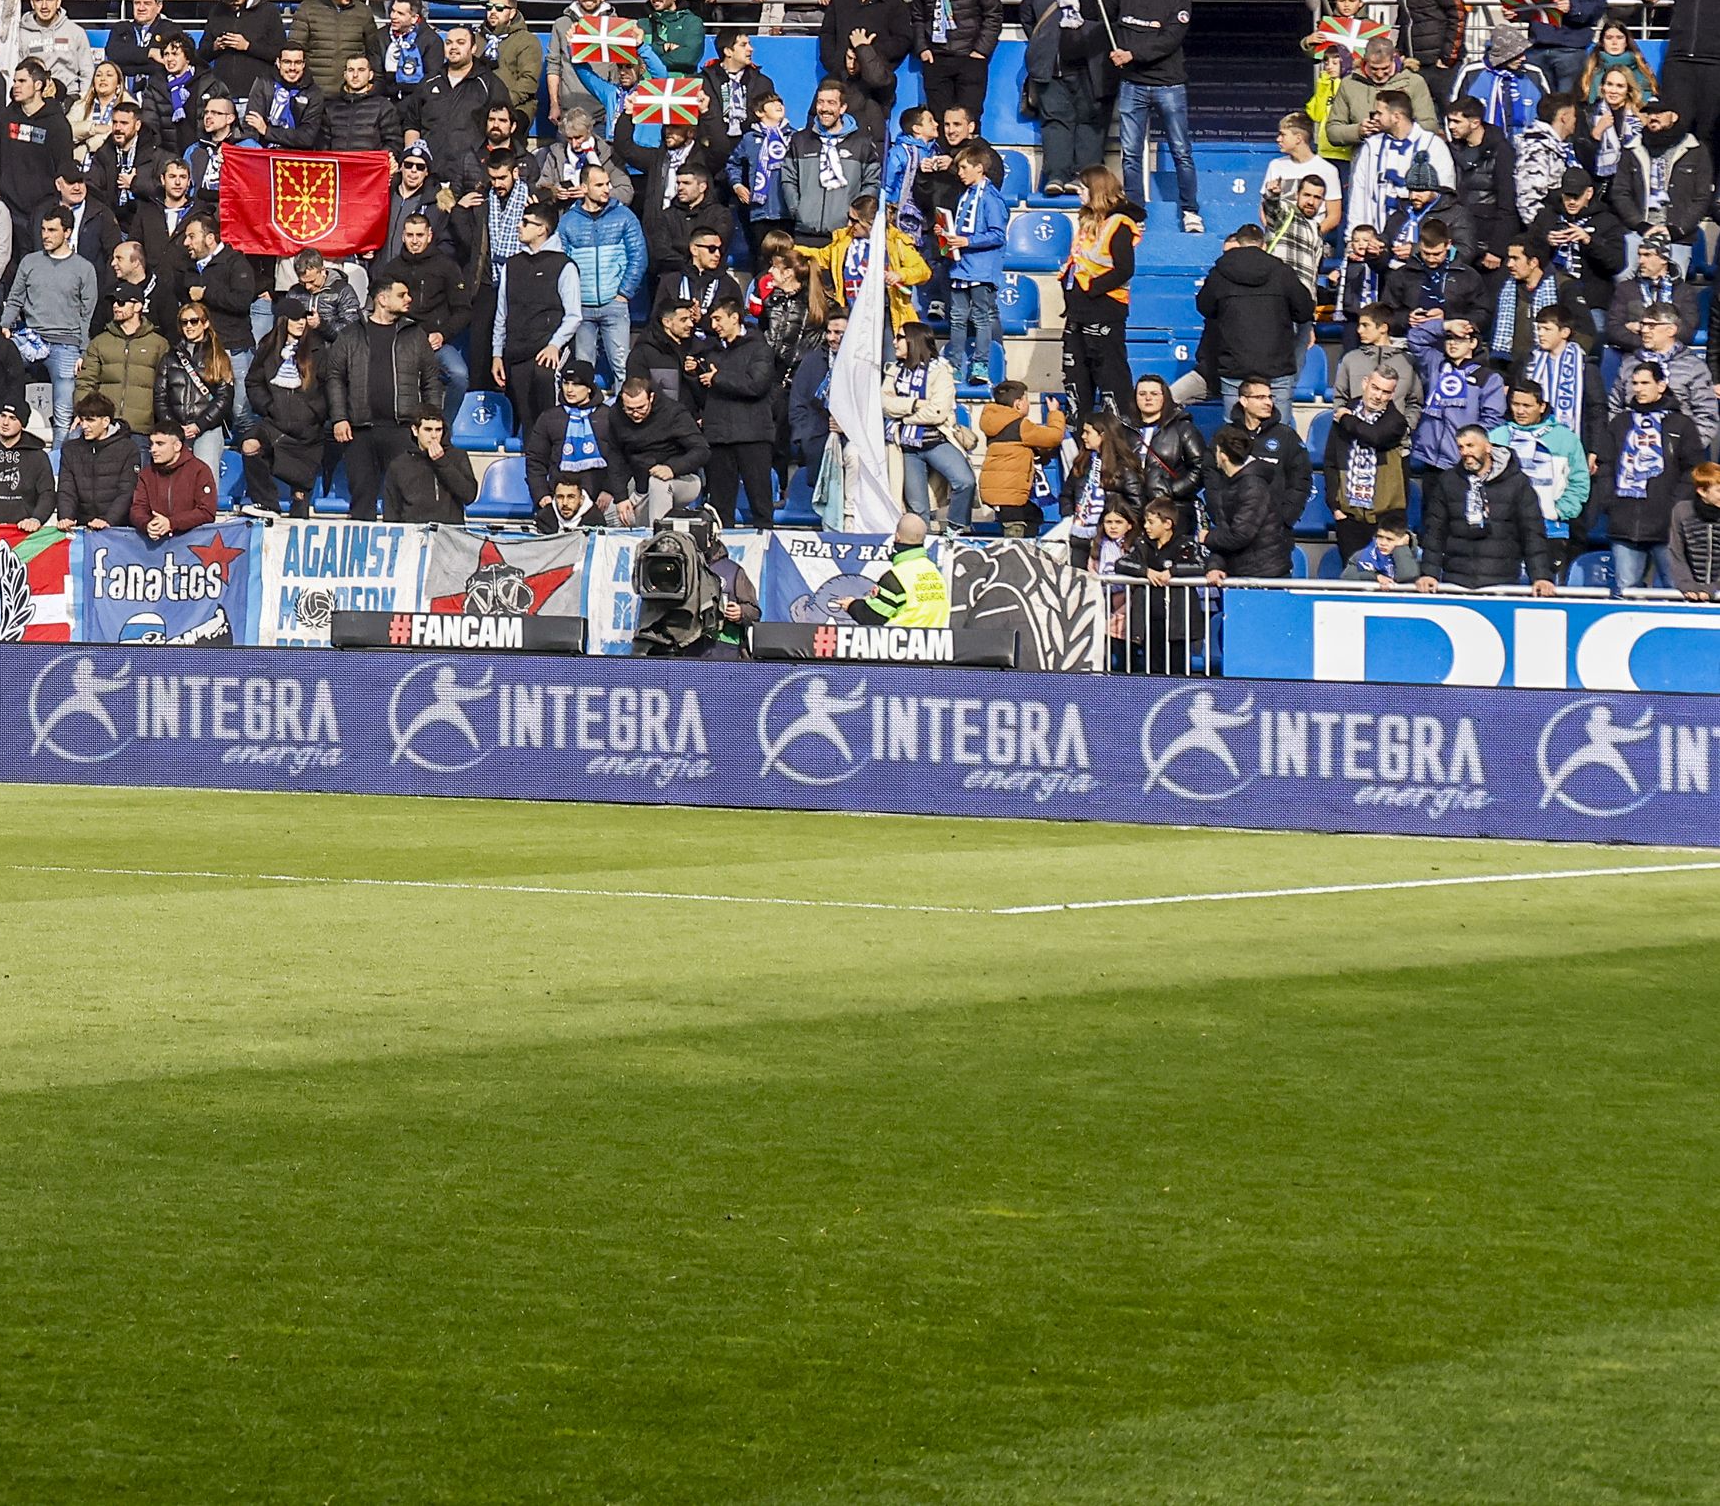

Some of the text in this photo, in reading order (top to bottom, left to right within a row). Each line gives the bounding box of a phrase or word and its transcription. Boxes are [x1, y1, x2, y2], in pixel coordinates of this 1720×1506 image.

[1231, 179, 1245, 194] 8
[1175, 346, 1189, 361] 6
[93, 547, 223, 604] fanatics
[282, 524, 404, 578] AGAINST
[790, 538, 854, 561] PLAY
[388, 613, 524, 648] #FANCAM
[813, 625, 954, 661] #FANCAM
[137, 675, 340, 744] INTEGRA
[499, 684, 709, 754] INTEGRA
[871, 695, 1091, 768] INTEGRA
[1261, 710, 1486, 785] INTEGRA
